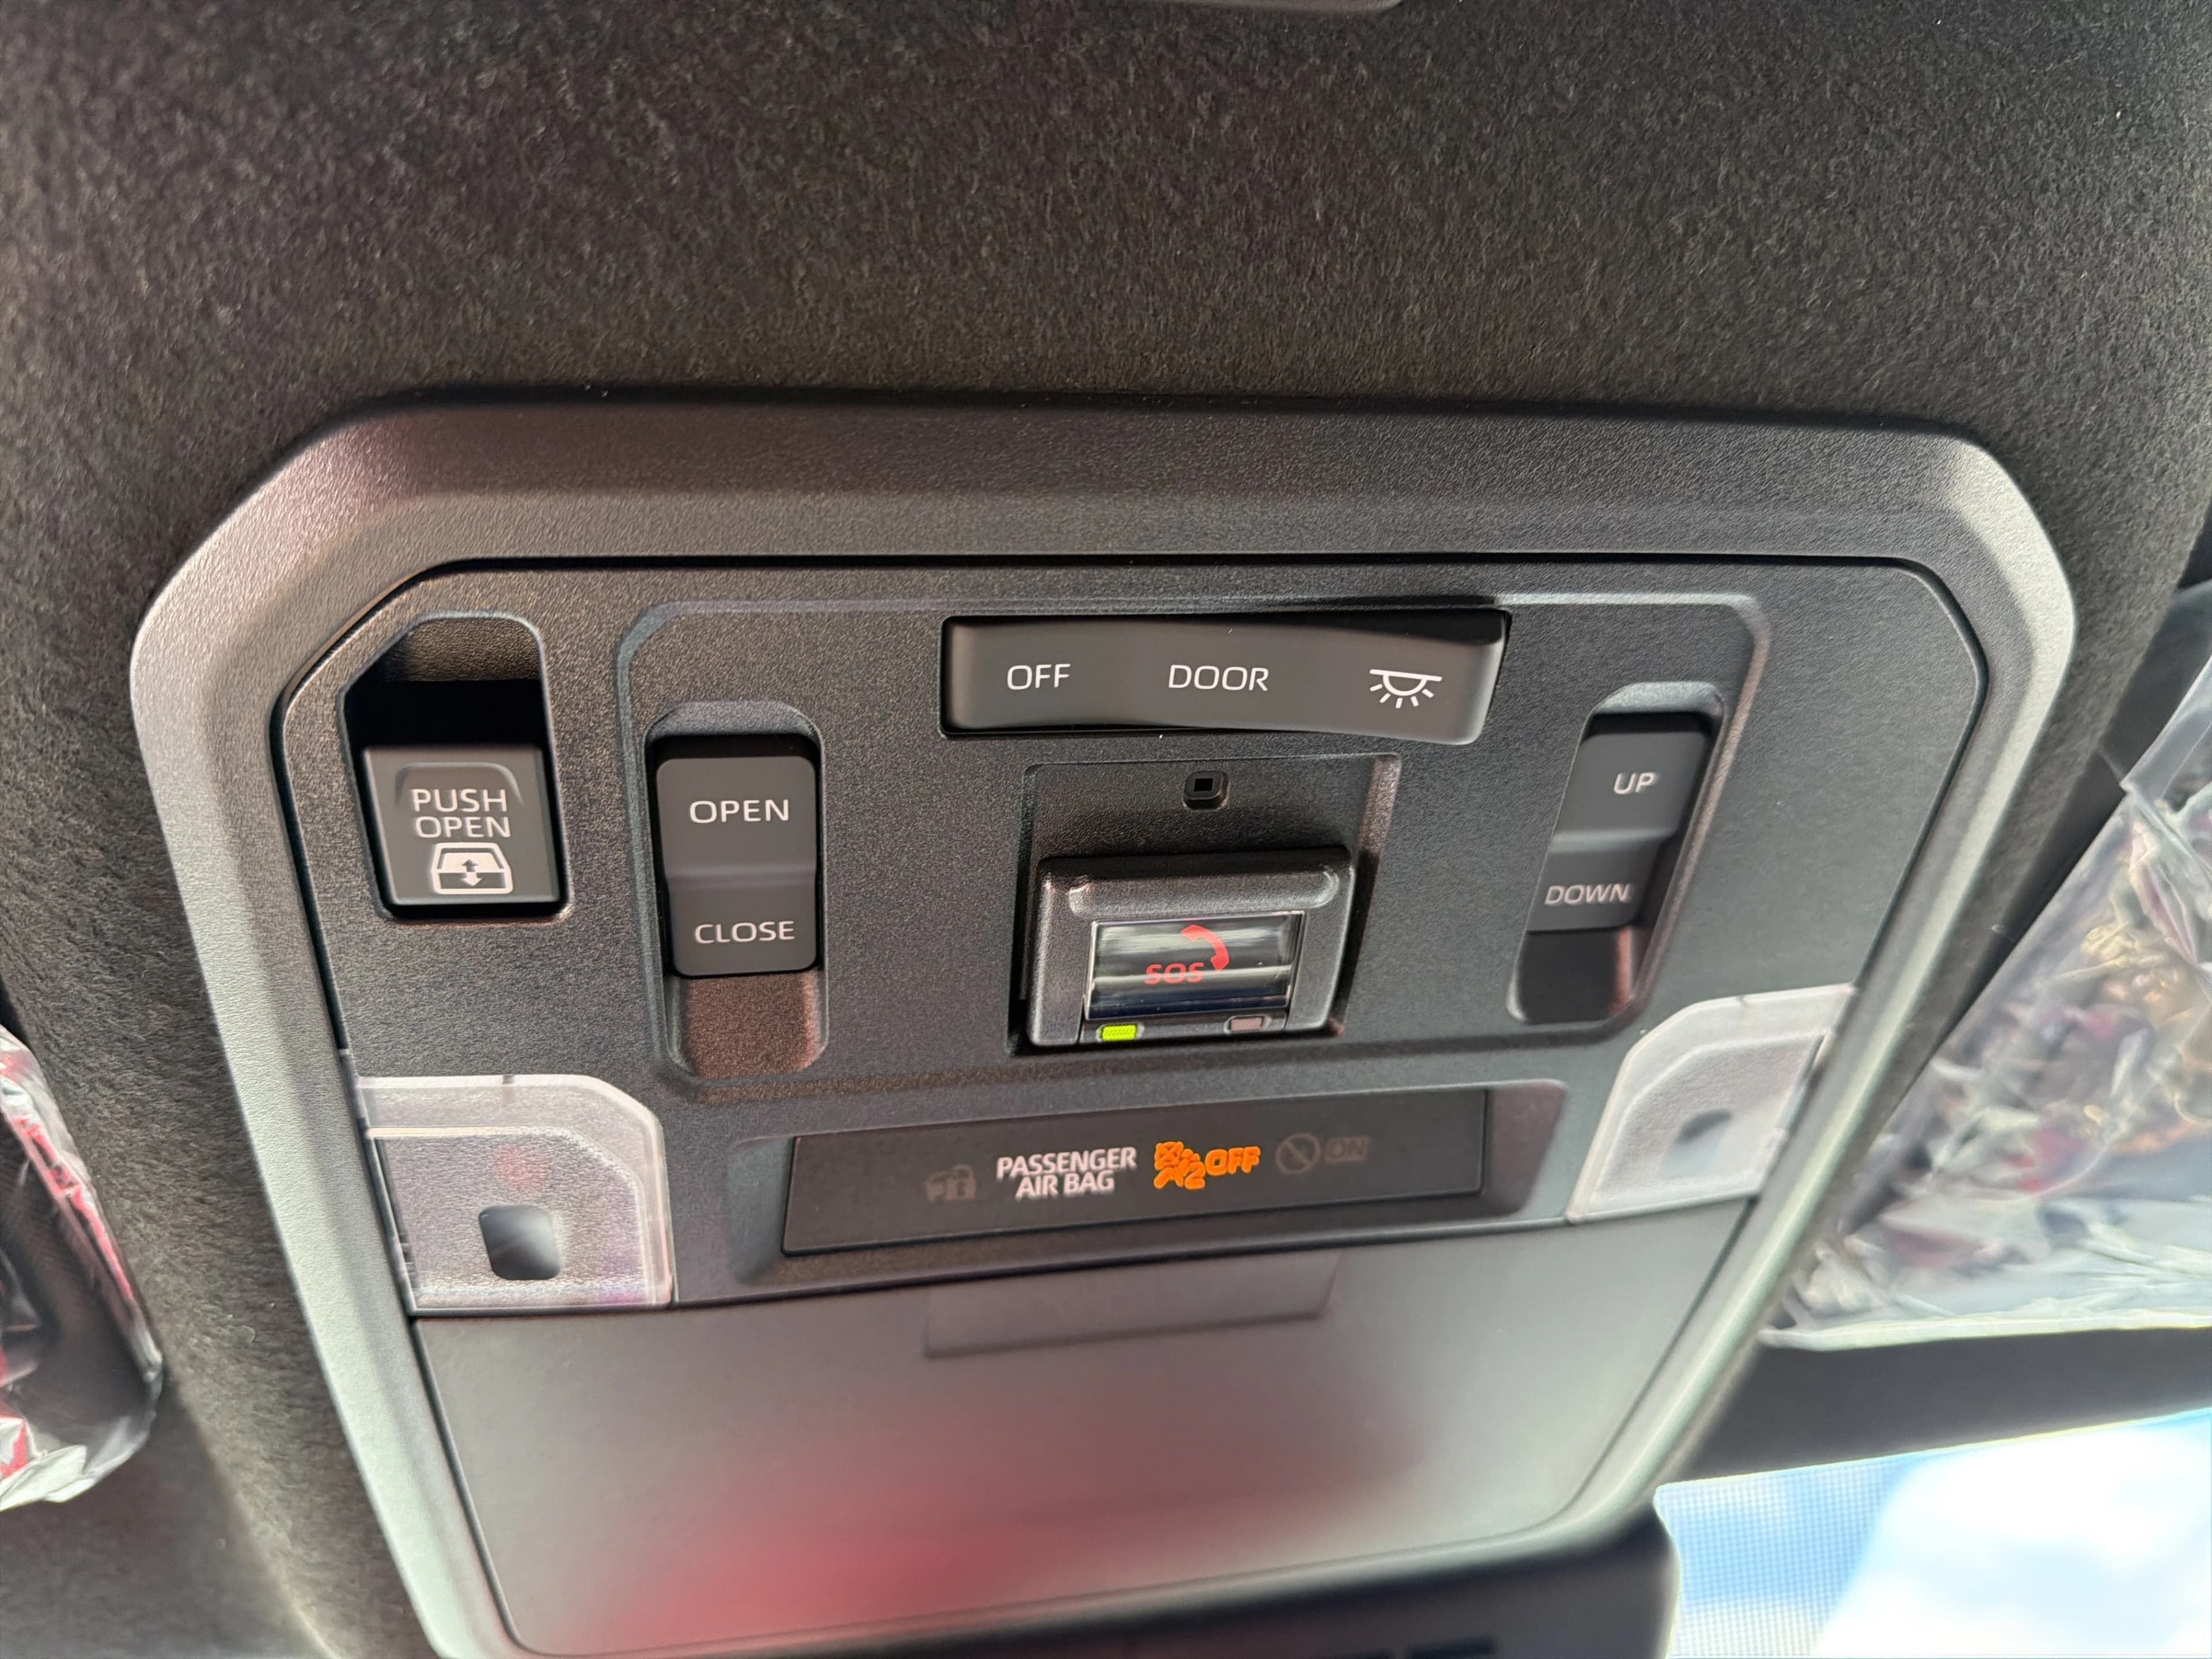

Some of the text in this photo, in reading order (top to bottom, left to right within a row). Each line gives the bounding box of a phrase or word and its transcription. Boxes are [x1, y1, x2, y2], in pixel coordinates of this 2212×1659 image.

[1006, 663, 1071, 690] OFF
[1168, 664, 1269, 691] DOOR
[1613, 771, 1657, 794] UP
[412, 787, 507, 813] PUSH
[689, 798, 789, 824] OPEN
[415, 816, 511, 838] OPEN
[1544, 883, 1631, 905] DOWN
[694, 920, 796, 945] CLOSE
[1145, 962, 1205, 984] SOS
[997, 1146, 1137, 1180] PASSENGER
[1205, 1146, 1262, 1176] OFF
[1015, 1169, 1115, 1201] AIR BAG
